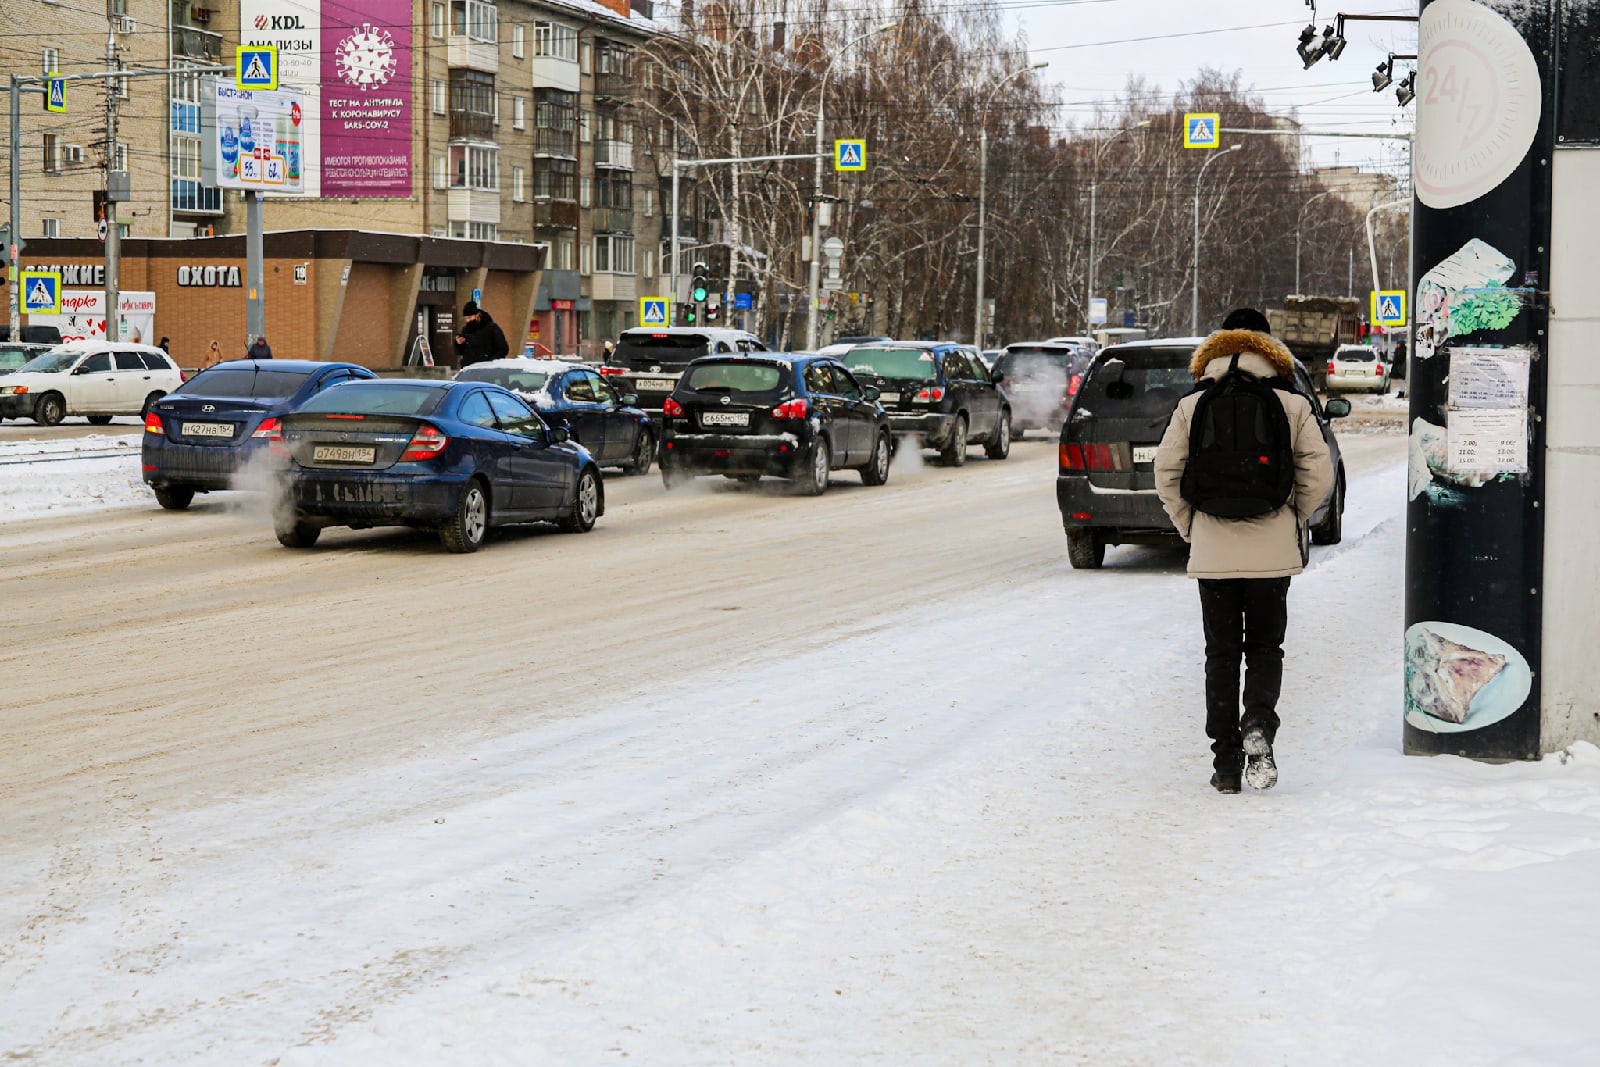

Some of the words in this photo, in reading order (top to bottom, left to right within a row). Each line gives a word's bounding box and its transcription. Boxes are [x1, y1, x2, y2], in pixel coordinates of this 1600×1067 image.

[271, 15, 305, 30] KDL
[329, 99, 347, 108] ТЕСТ
[349, 99, 360, 107] НА
[363, 98, 403, 107] АНТИТЕЛА
[332, 110, 338, 118] К
[340, 109, 401, 118] КОРОНАВИРУСУ
[344, 120, 389, 129] SARS-COV-2
[178, 266, 241, 287] ОХОТА
[295, 266, 306, 279] 19
[316, 448, 355, 460] О749ВН
